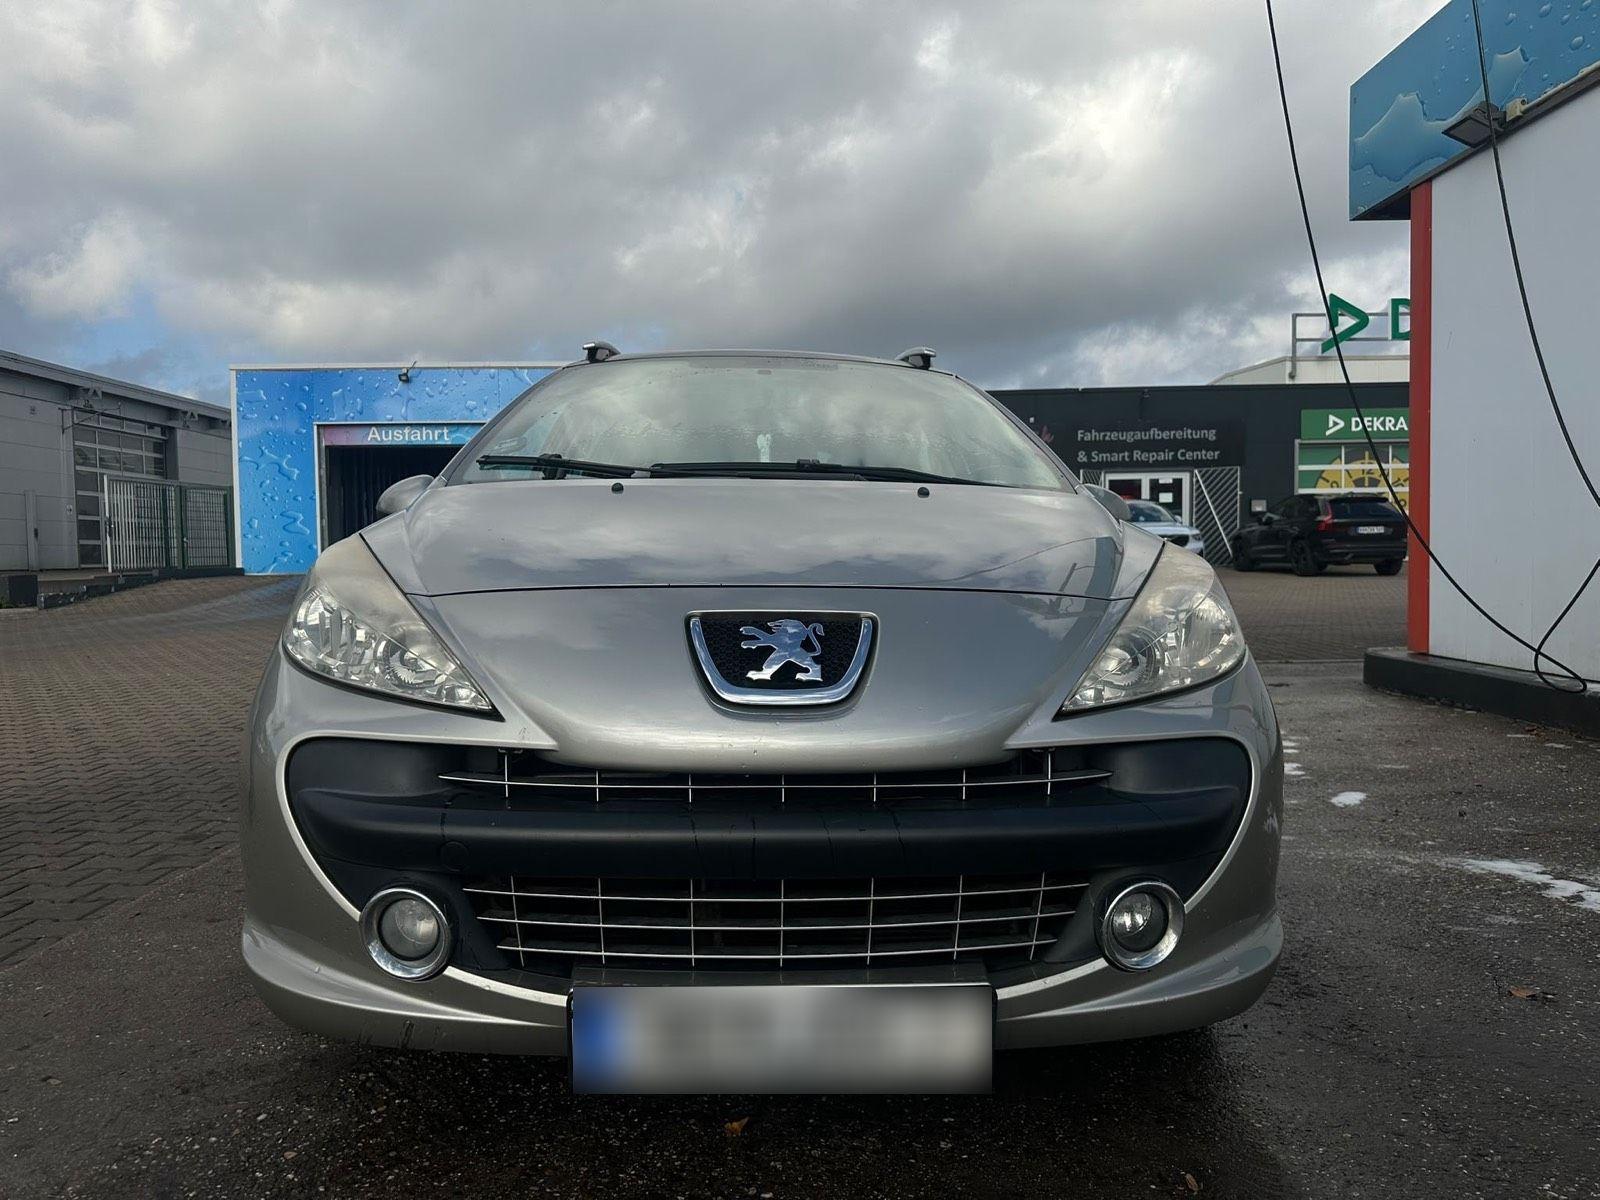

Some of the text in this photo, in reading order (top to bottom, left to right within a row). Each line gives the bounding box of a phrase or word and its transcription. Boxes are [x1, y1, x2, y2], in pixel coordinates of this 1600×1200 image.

[1351, 416, 1409, 432] DEKRA
[367, 426, 450, 442] Ausfahrt
[1077, 427, 1217, 442] Fahrzeugaufbereitung
[1077, 449, 1220, 464] & Smart Repair Center
